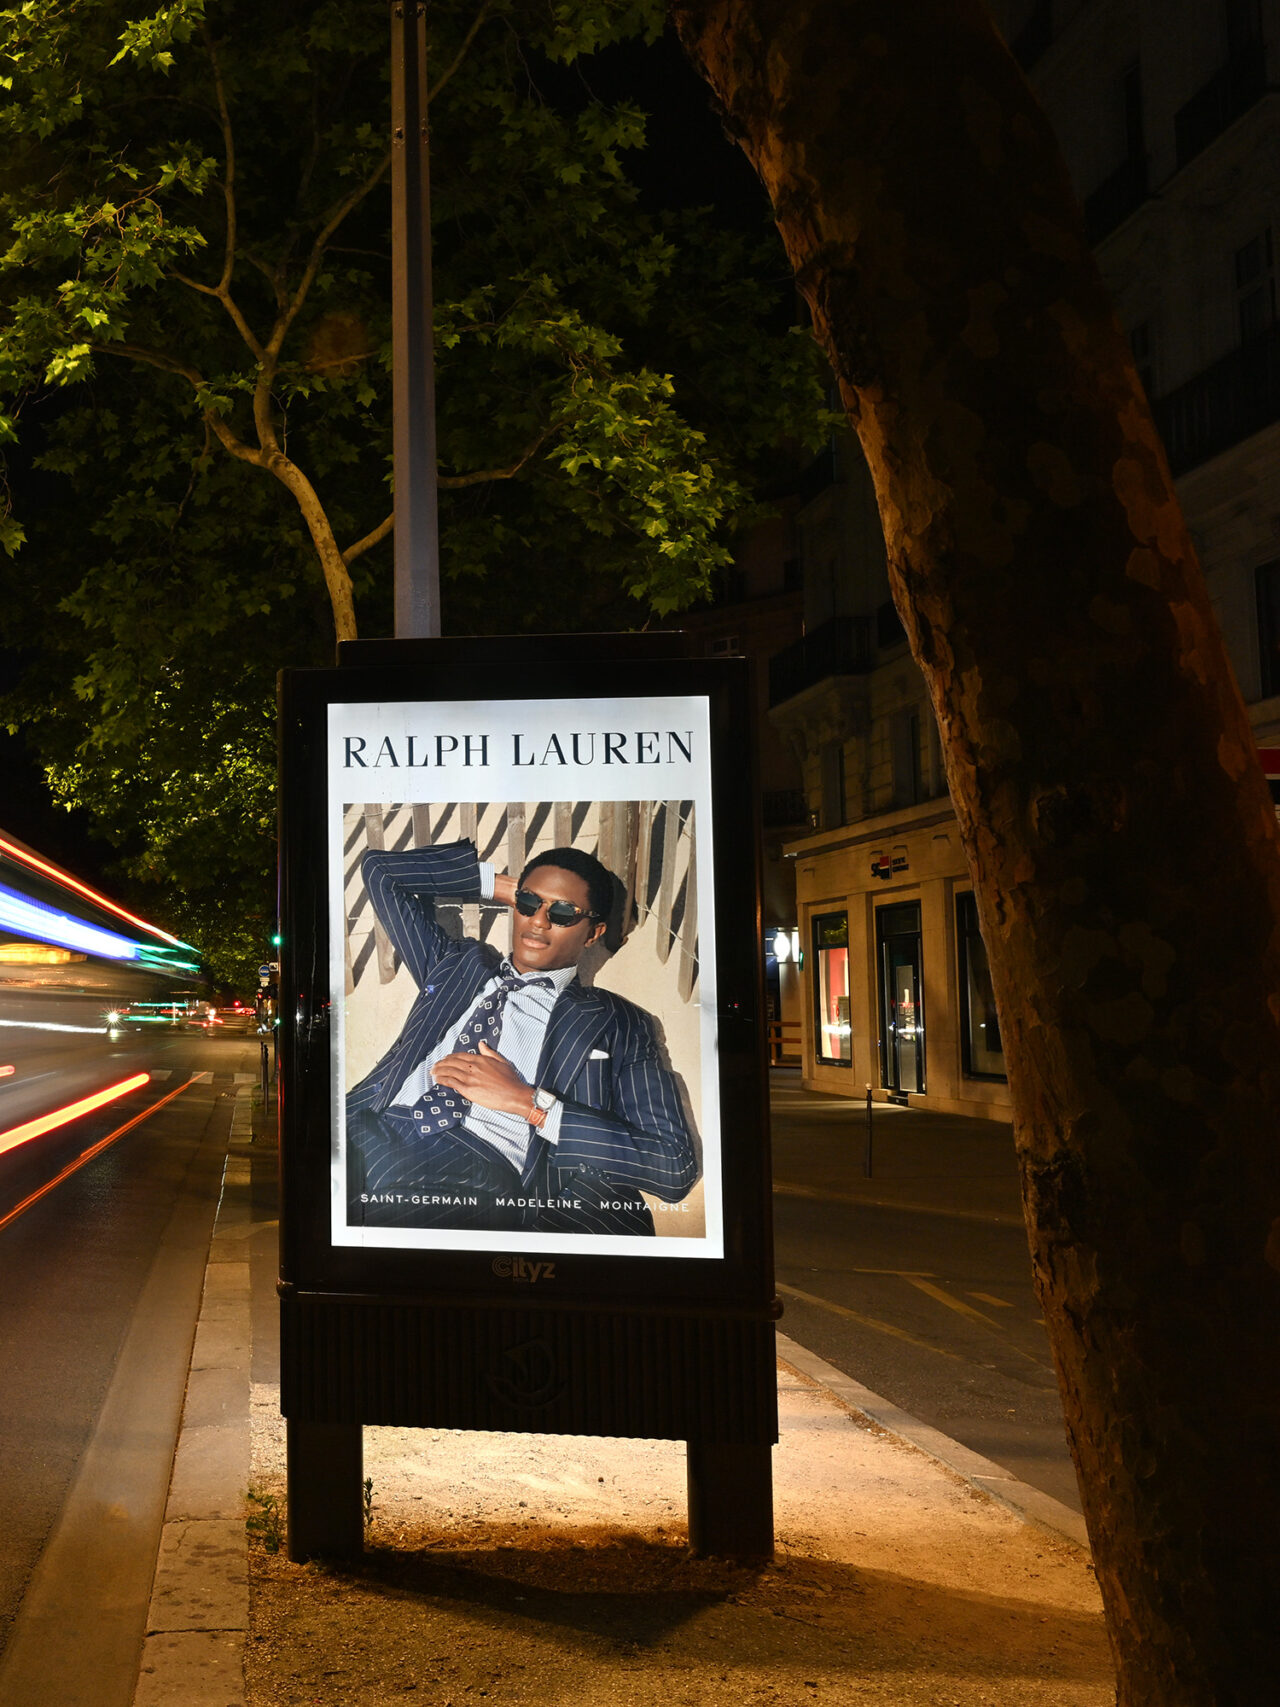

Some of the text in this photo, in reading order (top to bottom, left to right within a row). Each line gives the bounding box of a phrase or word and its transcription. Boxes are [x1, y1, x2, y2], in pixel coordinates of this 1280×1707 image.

[342, 731, 694, 768] RALPH LAUREN
[360, 1193, 690, 1213] SAINT-GERMAIN MADELEINE MONTAIGNE
[491, 1255, 556, 1283] Cityz
